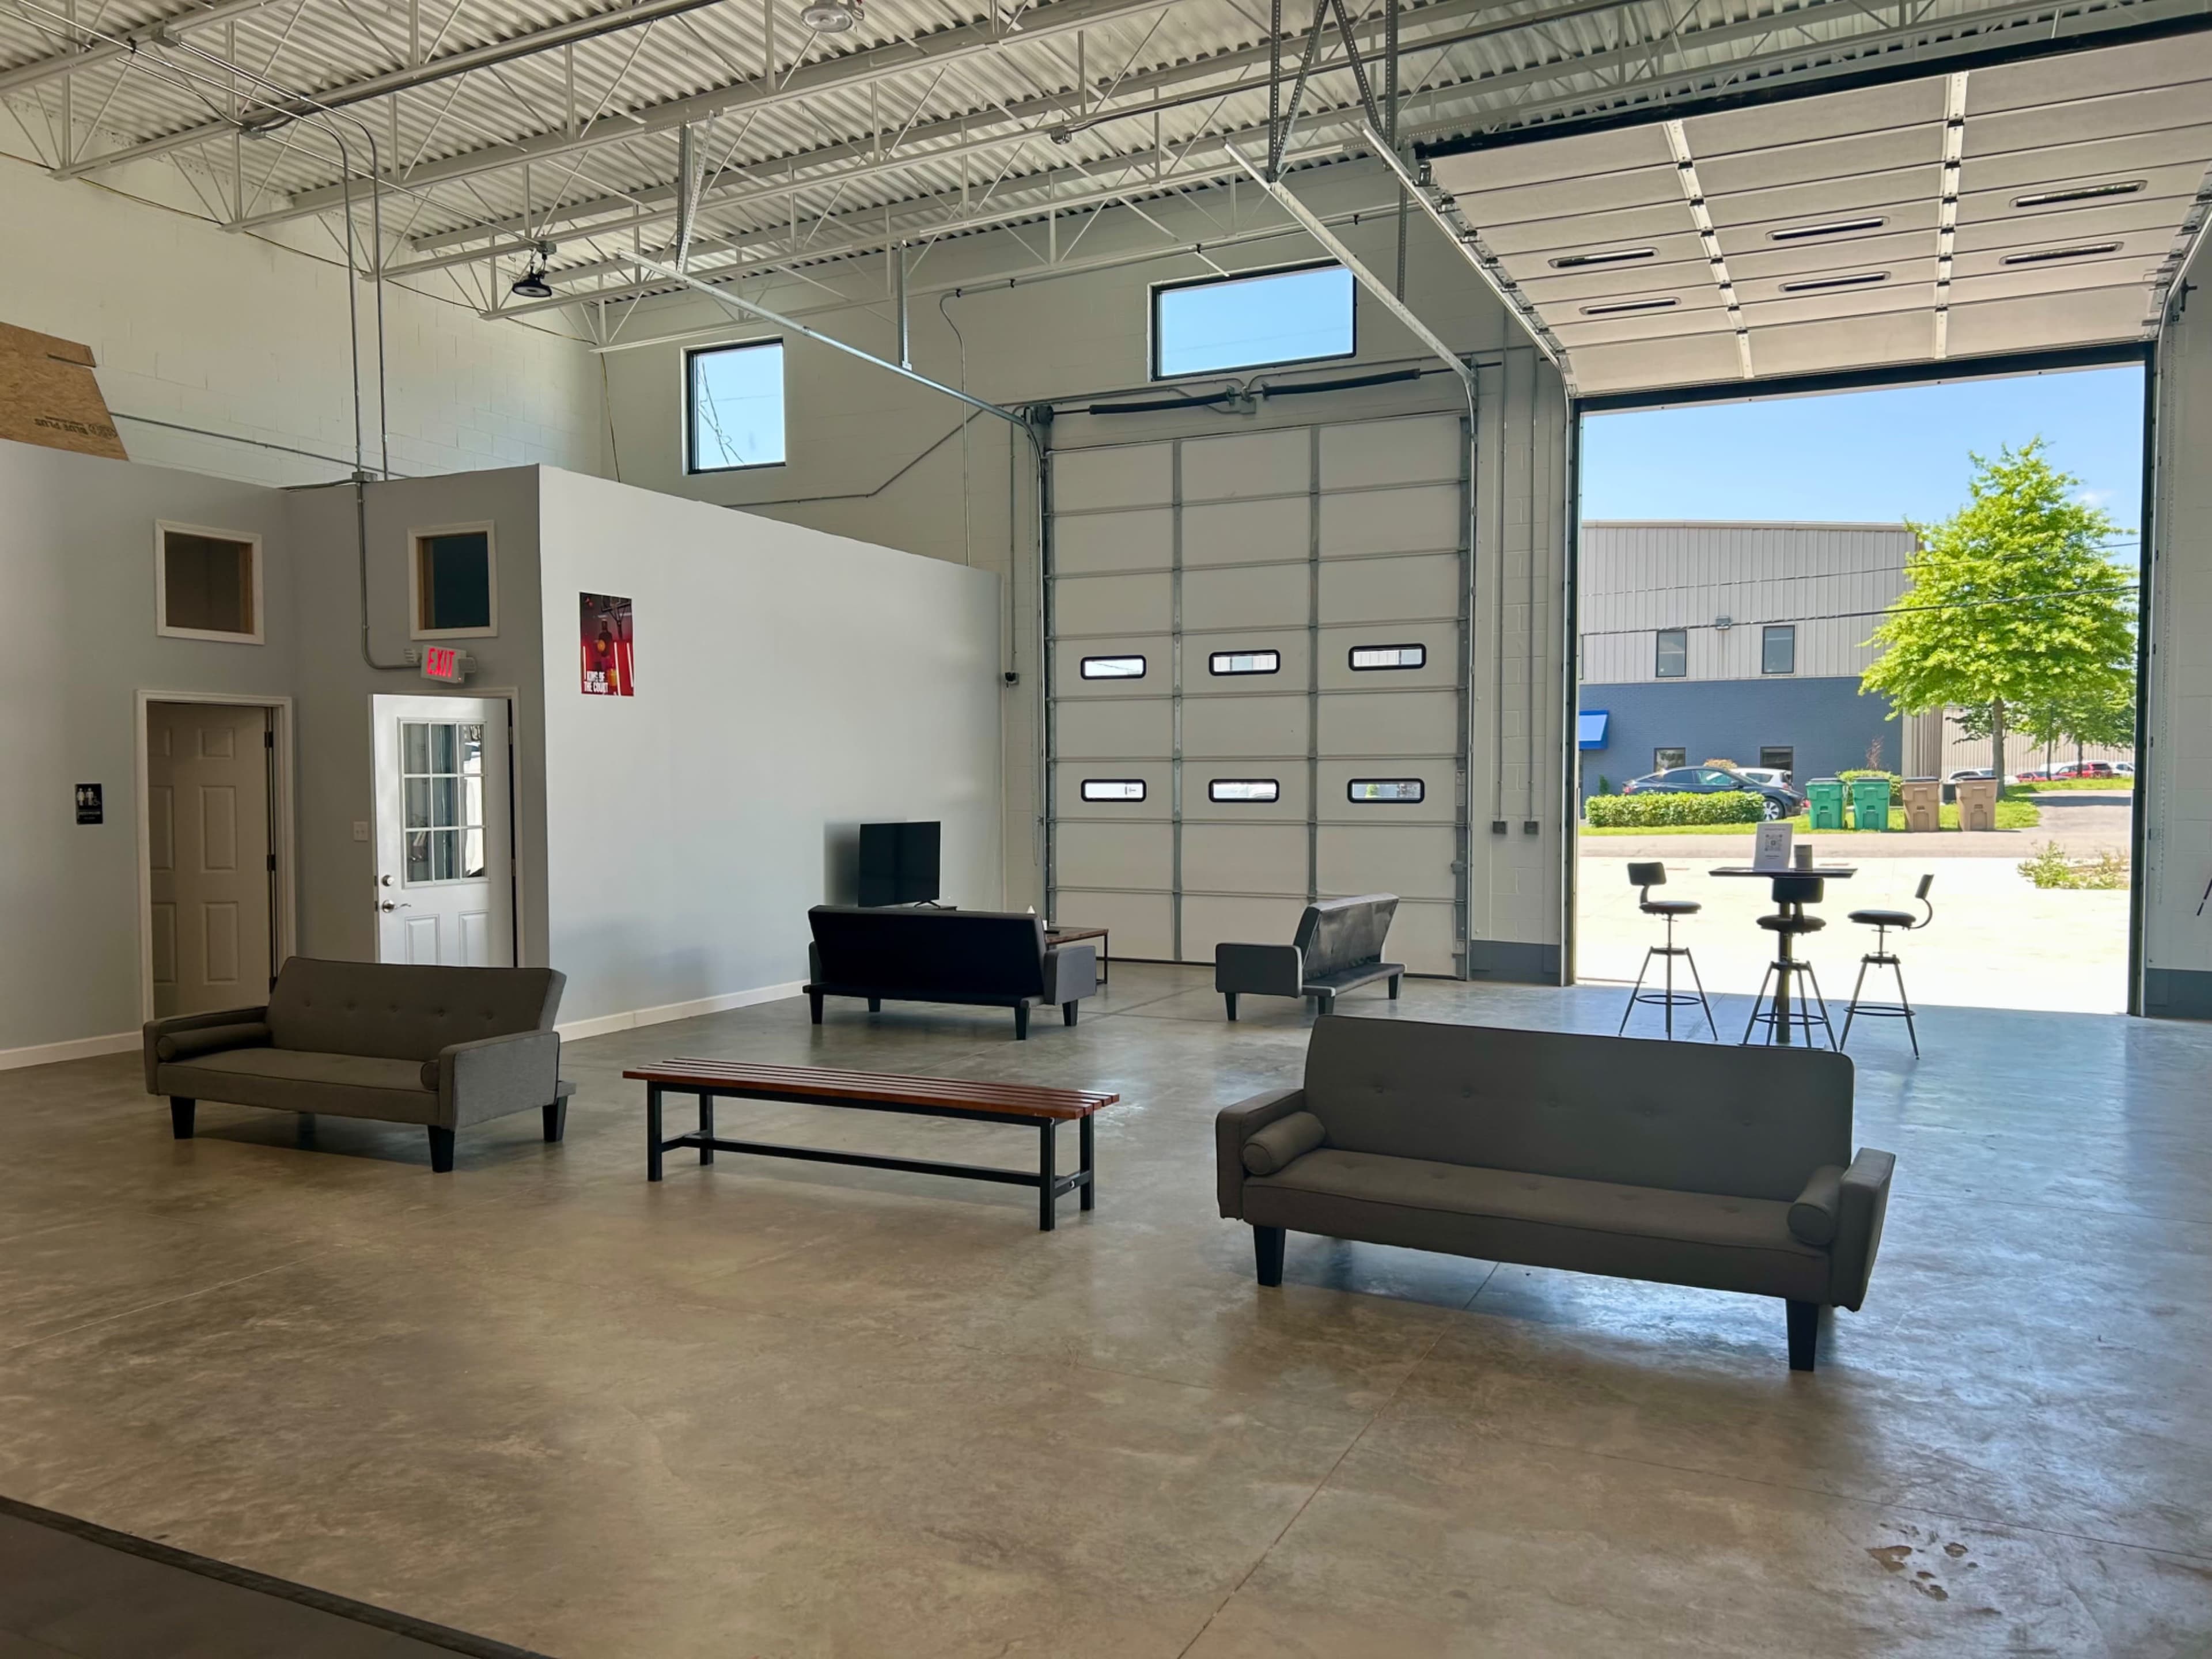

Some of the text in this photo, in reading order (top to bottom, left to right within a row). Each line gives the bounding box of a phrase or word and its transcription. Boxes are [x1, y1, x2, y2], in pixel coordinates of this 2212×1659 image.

[426, 647, 455, 678] EXIT
[584, 681, 608, 693] THE COURT
